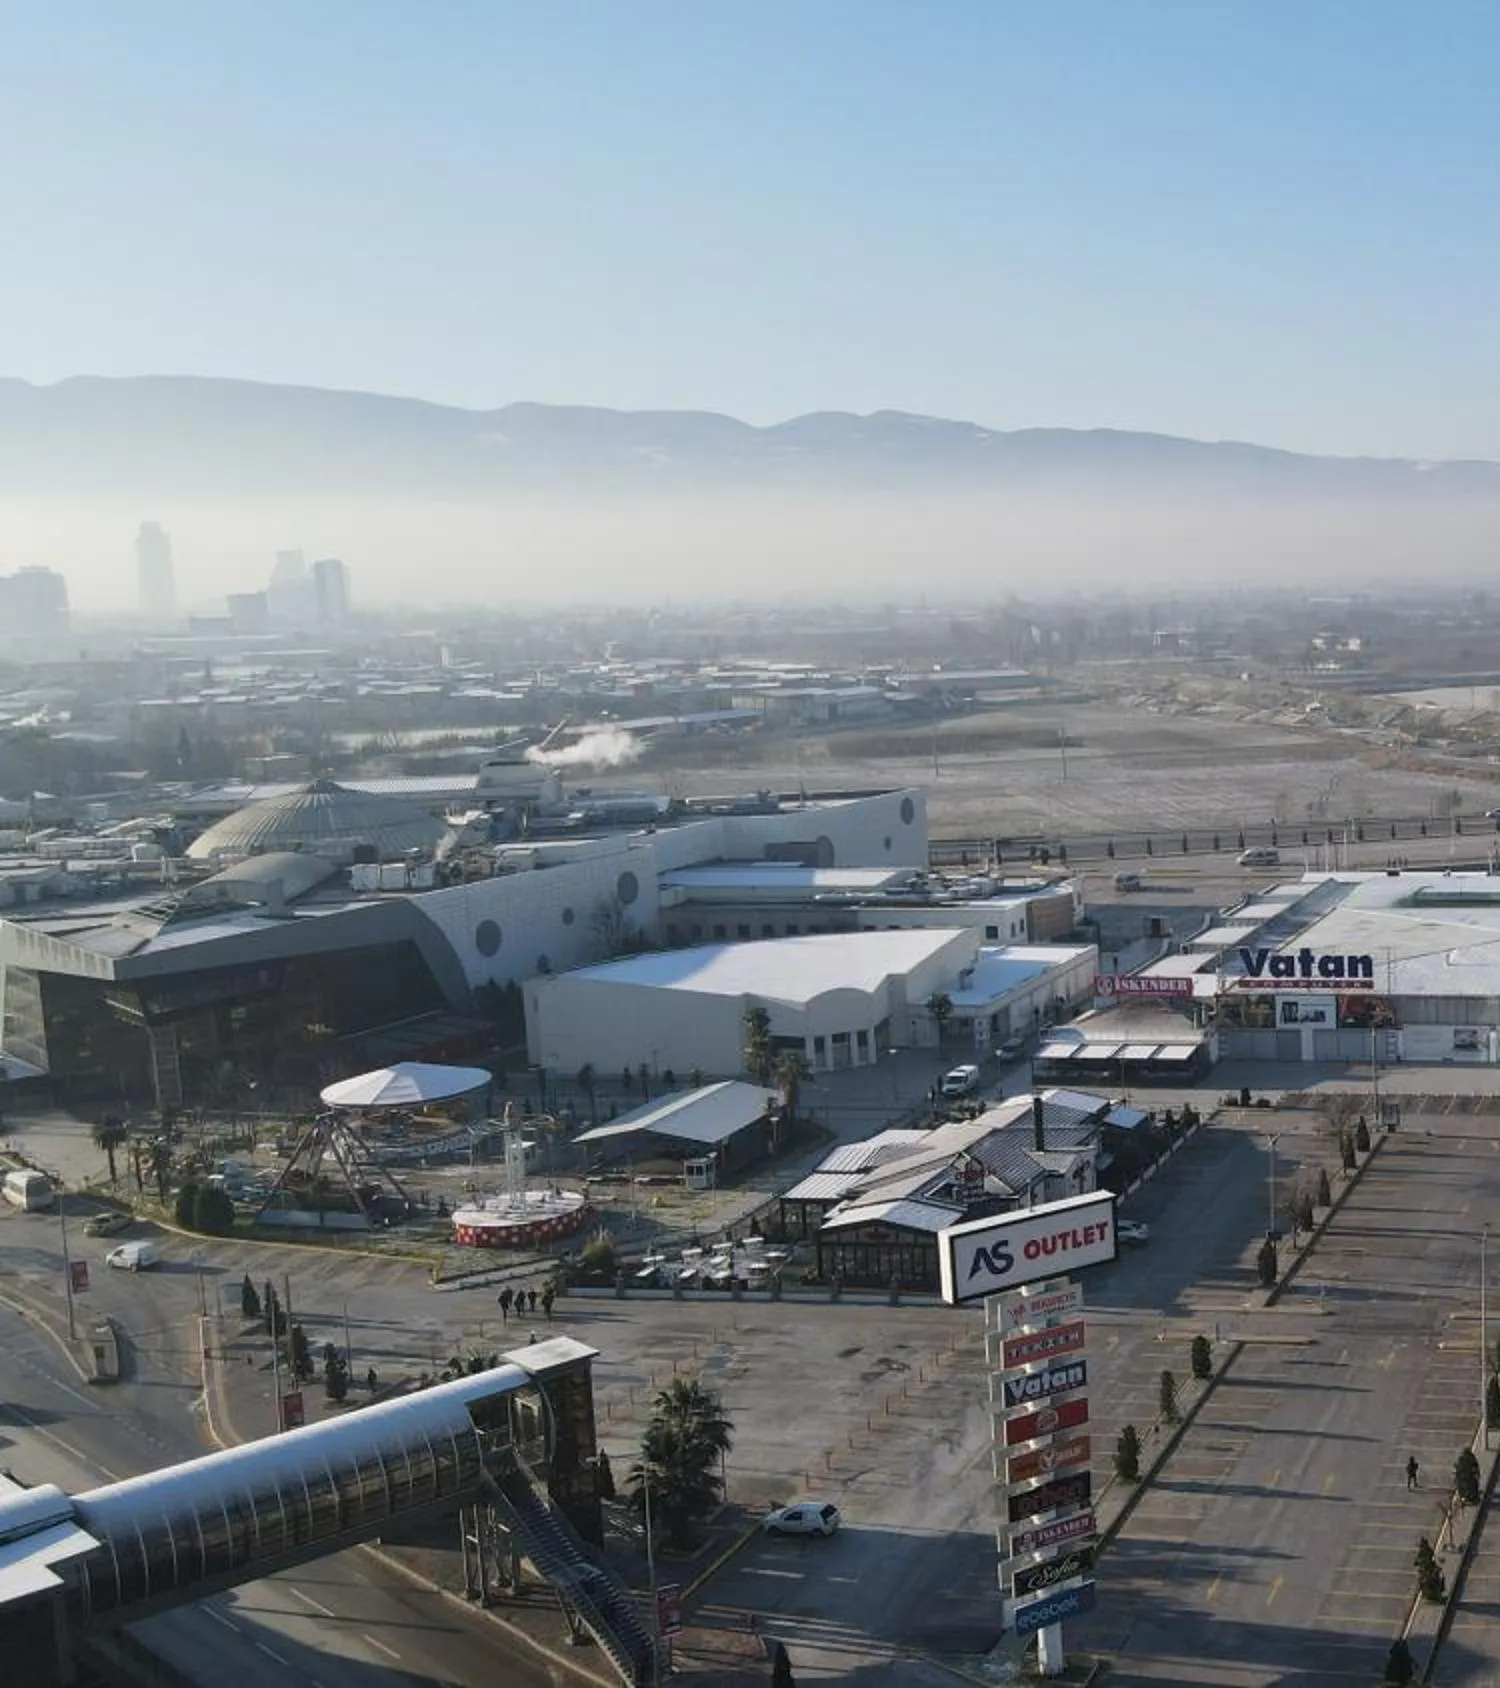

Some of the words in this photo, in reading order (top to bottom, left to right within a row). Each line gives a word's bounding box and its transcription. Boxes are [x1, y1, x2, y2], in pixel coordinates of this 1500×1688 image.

[1239, 948, 1373, 978] Vatan
[968, 1240, 1014, 1280] AS
[1023, 1222, 1108, 1260] OUTLET
[1009, 1365, 1083, 1398] Vatan
